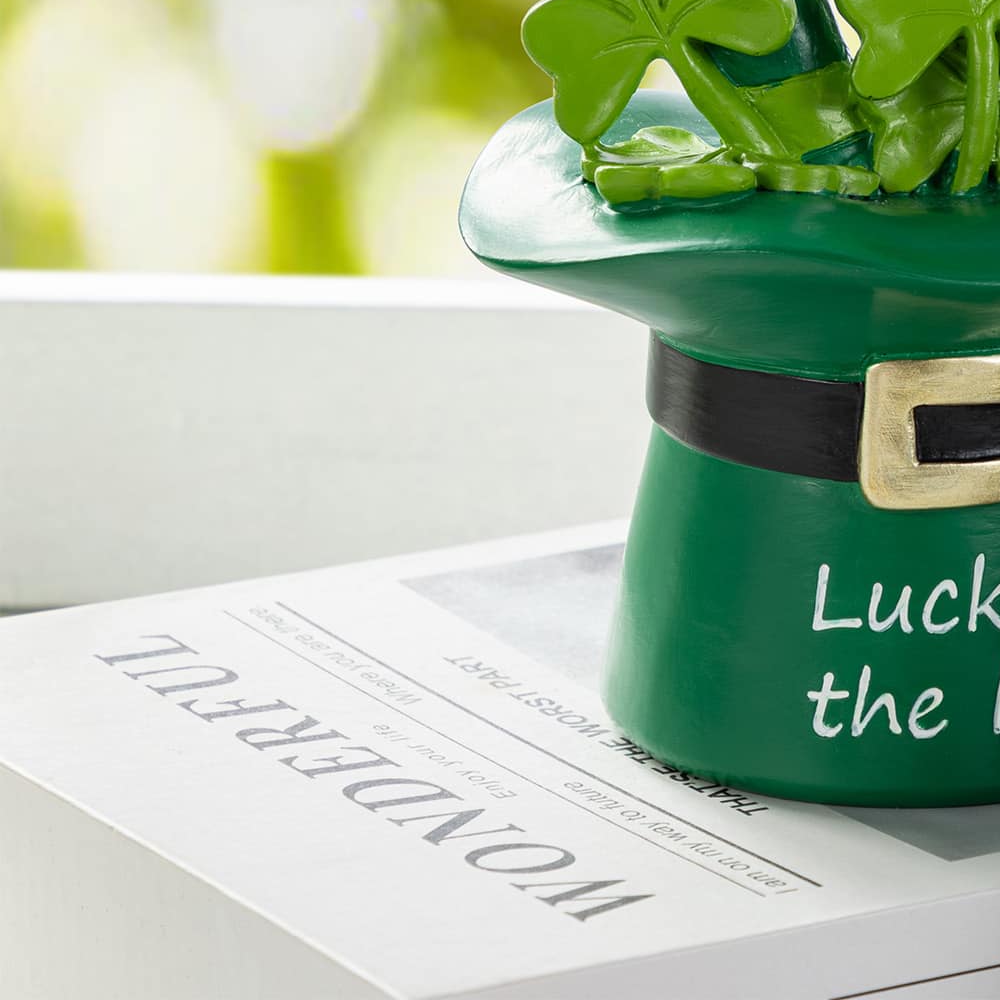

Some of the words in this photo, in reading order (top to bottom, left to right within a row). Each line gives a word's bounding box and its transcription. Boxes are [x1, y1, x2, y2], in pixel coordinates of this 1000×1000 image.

[324, 652, 373, 671] you
[442, 655, 522, 690] PART
[360, 672, 423, 705] Where
[807, 664, 949, 740] the
[508, 690, 609, 739] WORST
[373, 721, 408, 742] life
[408, 743, 463, 768] your
[600, 736, 654, 765] THE
[92, 634, 656, 923] WONDERFUL
[458, 768, 518, 800] Enjoy
[564, 780, 618, 811] future
[620, 808, 648, 823] to
[640, 820, 689, 843] way
[682, 841, 718, 858] my
[717, 855, 751, 873] on
[746, 871, 788, 889] am
